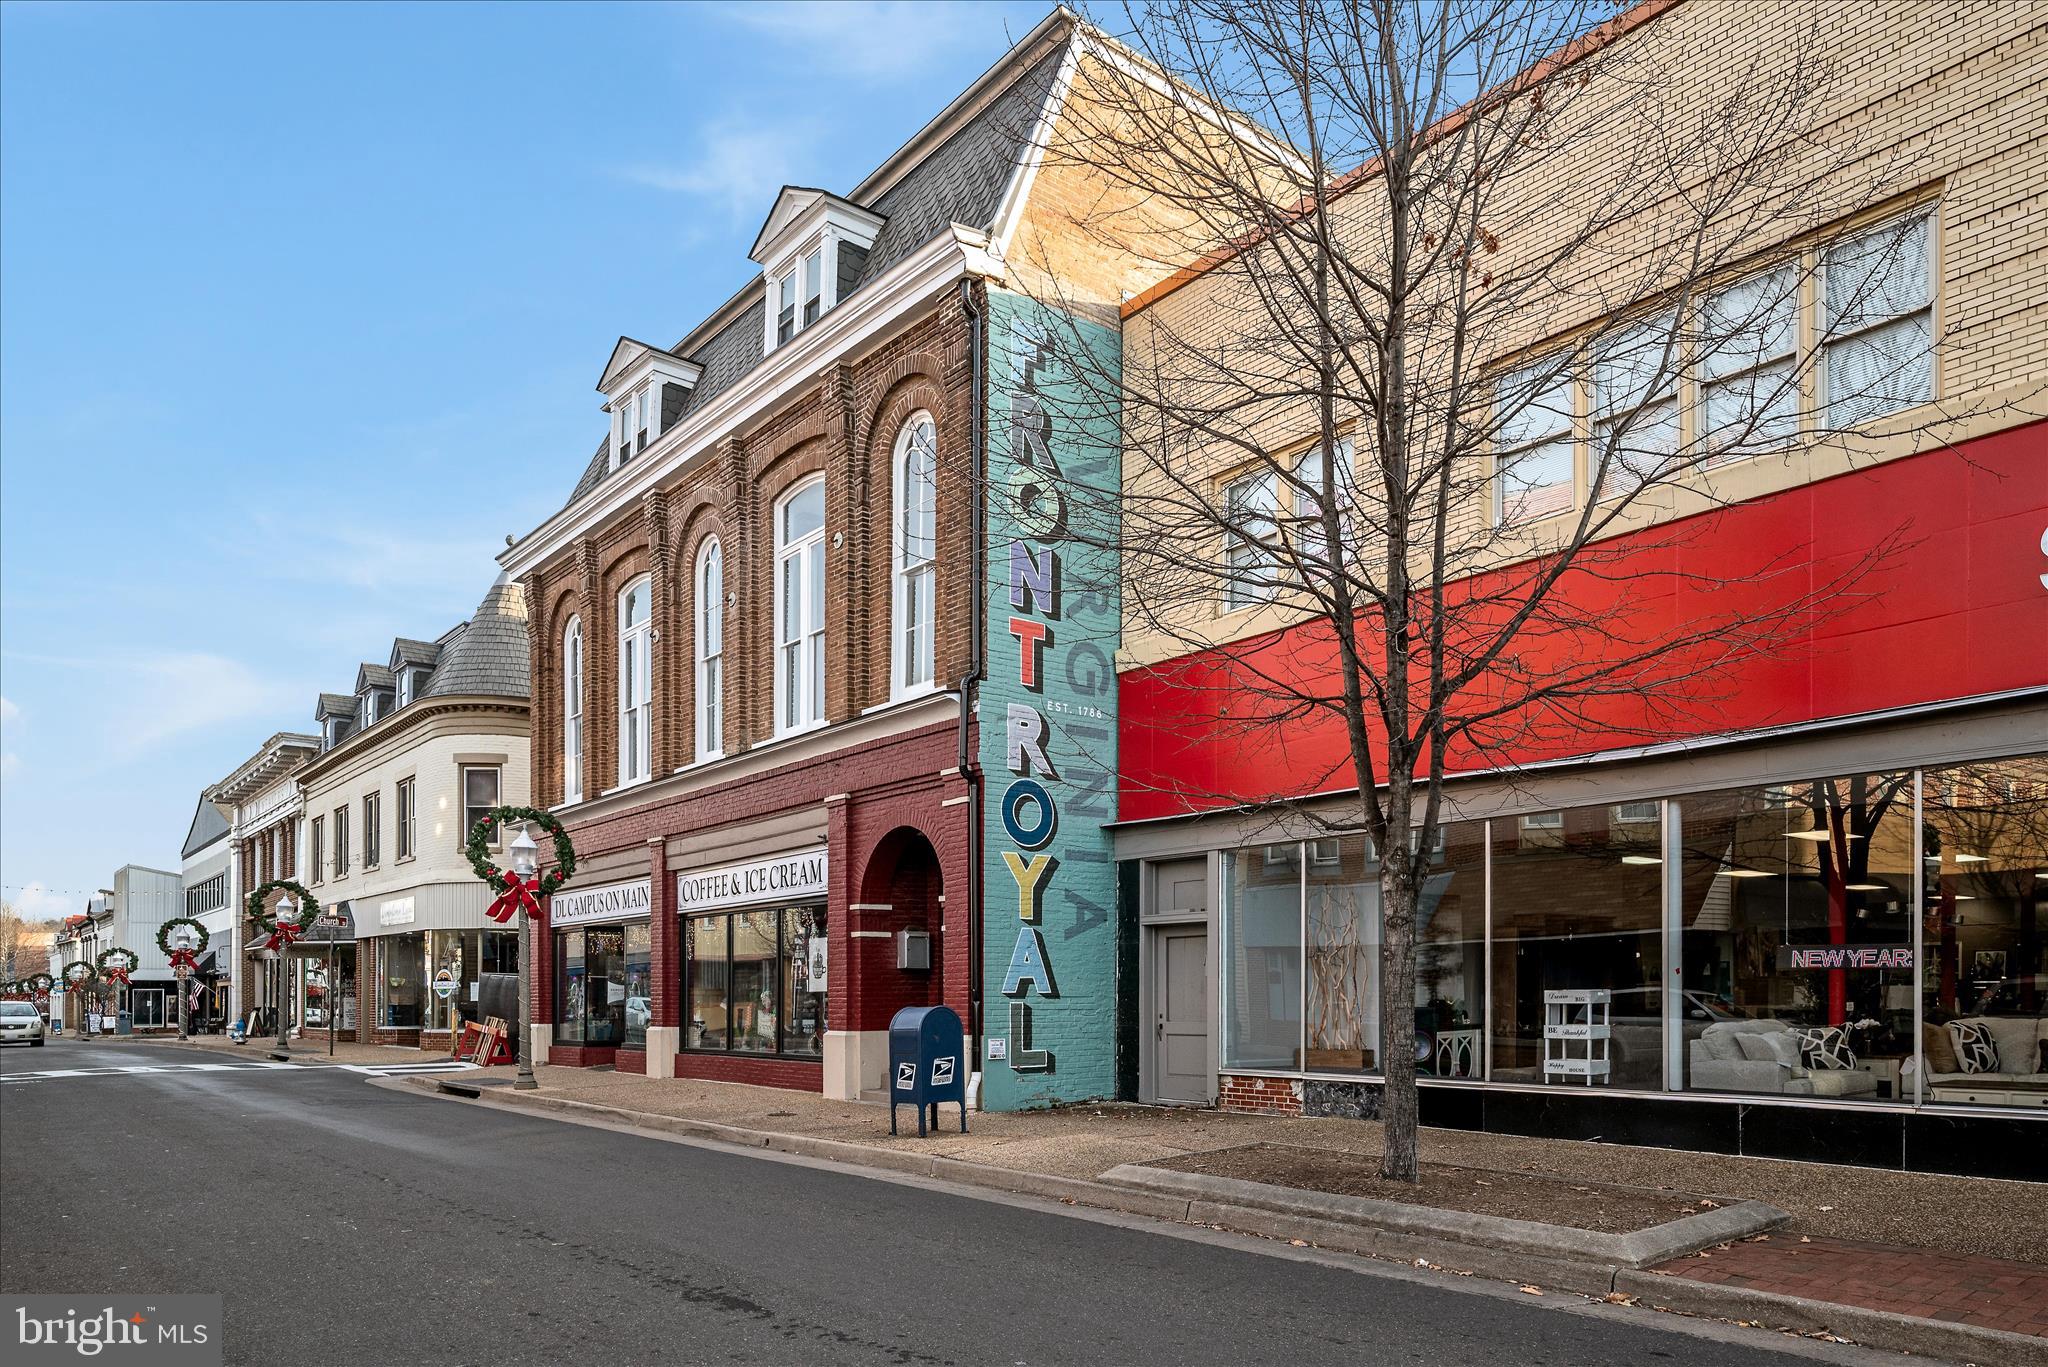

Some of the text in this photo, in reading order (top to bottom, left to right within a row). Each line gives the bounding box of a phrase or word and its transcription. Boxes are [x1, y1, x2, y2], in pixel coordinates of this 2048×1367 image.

[1007, 316, 1064, 691] FRONT
[1047, 700, 1073, 714] EST.
[682, 858, 823, 903] COFFEE & ICE CREAM
[1001, 702, 1058, 1071] ROYAL
[555, 885, 649, 918] DL CAMPUS ON MAIN
[319, 915, 340, 926] Church
[1791, 948, 1913, 968] NEW YEAR
